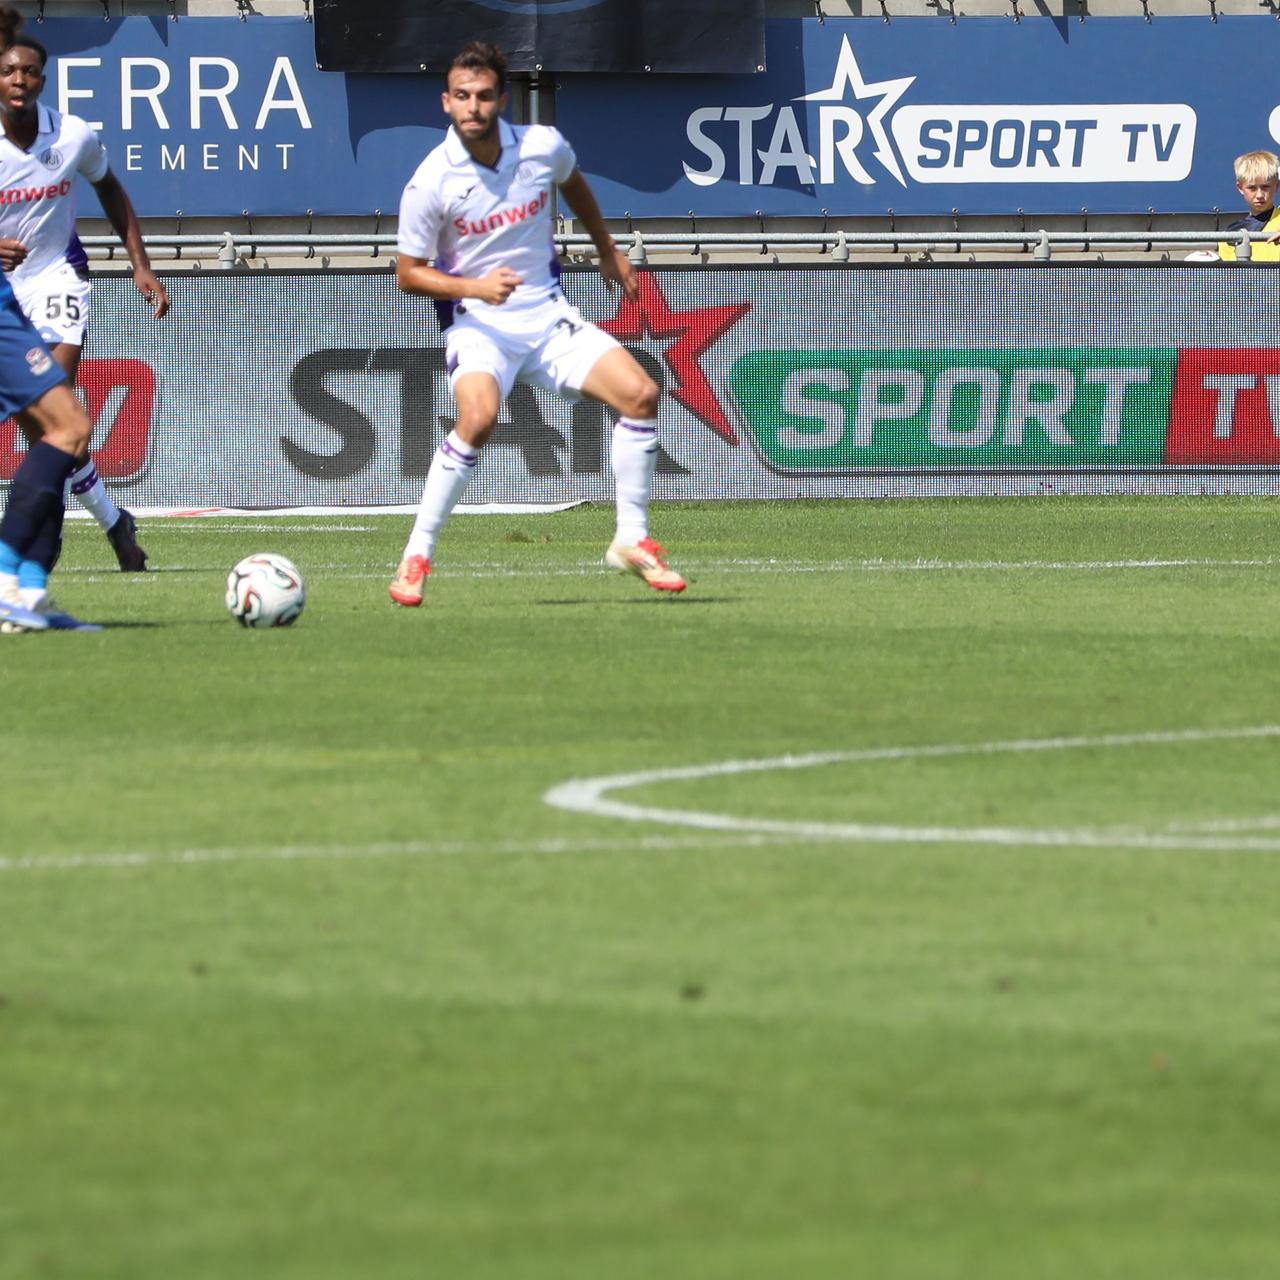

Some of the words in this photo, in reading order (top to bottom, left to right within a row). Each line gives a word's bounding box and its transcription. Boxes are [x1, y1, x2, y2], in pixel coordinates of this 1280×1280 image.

[57, 56, 313, 131] ERRA
[683, 103, 908, 189] STAR
[918, 117, 1098, 170] SPORT
[1122, 122, 1182, 163] TV
[46, 294, 81, 321] 55
[775, 367, 1152, 452] SPORT
